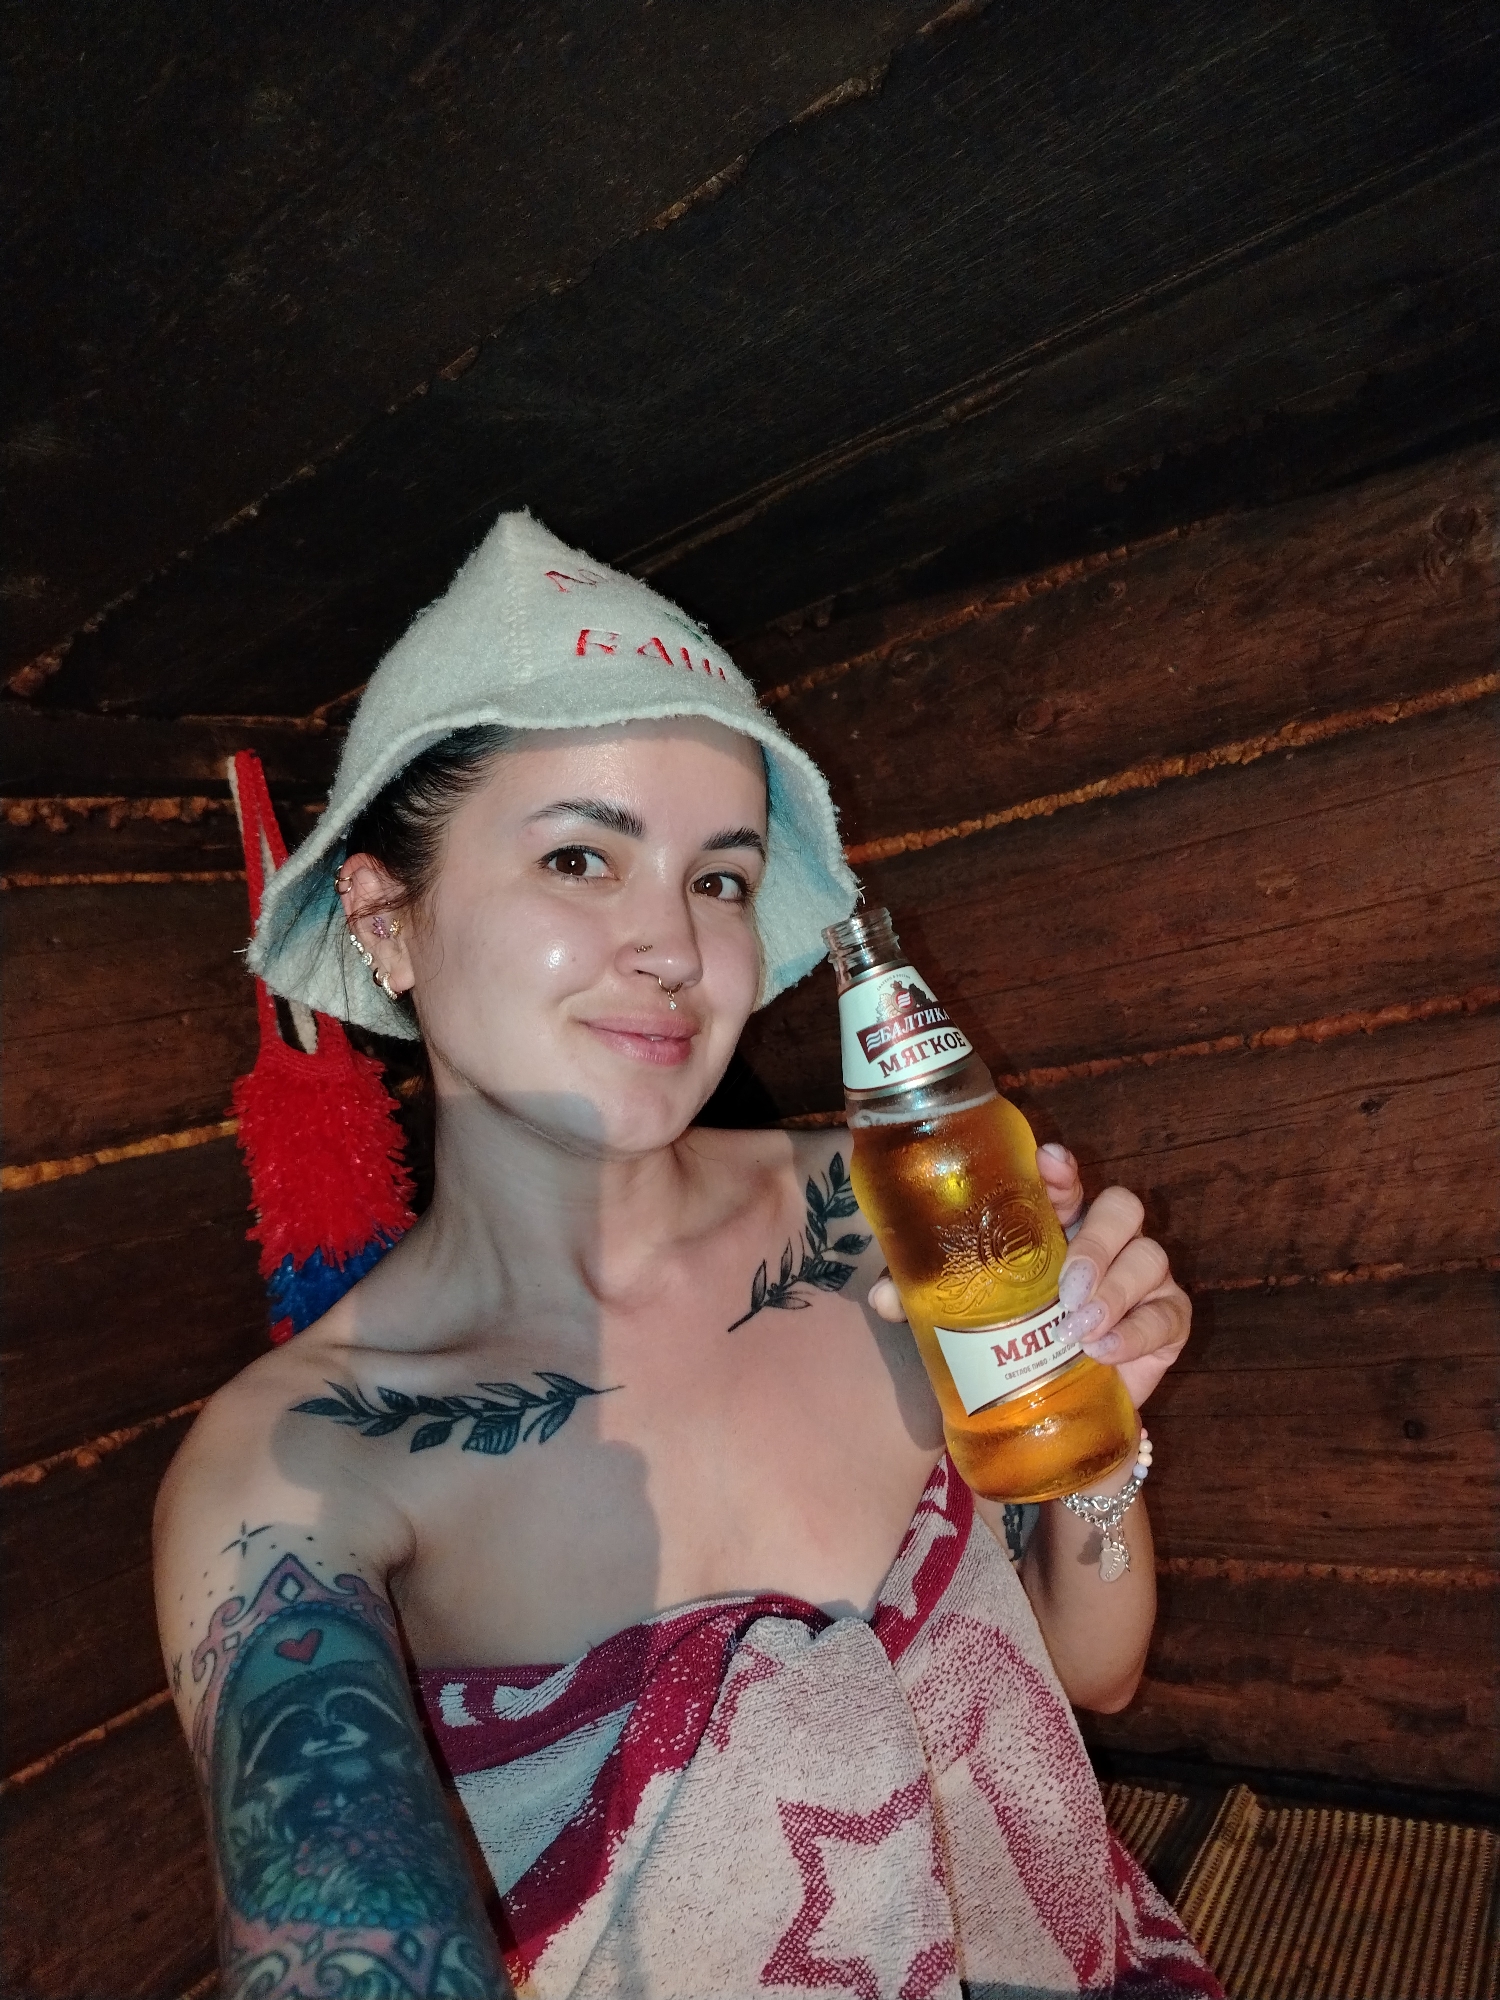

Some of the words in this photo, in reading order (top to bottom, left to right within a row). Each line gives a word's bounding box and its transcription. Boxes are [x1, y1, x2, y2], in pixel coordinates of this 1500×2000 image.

[880, 1006, 950, 1044] БАЛТИКА
[877, 1031, 966, 1079] МЯГКОЕ
[990, 1311, 1067, 1367] МЯГ
[1004, 1365, 1032, 1381] СВЕТЛОЕ
[1031, 1357, 1048, 1371] ПИВО
